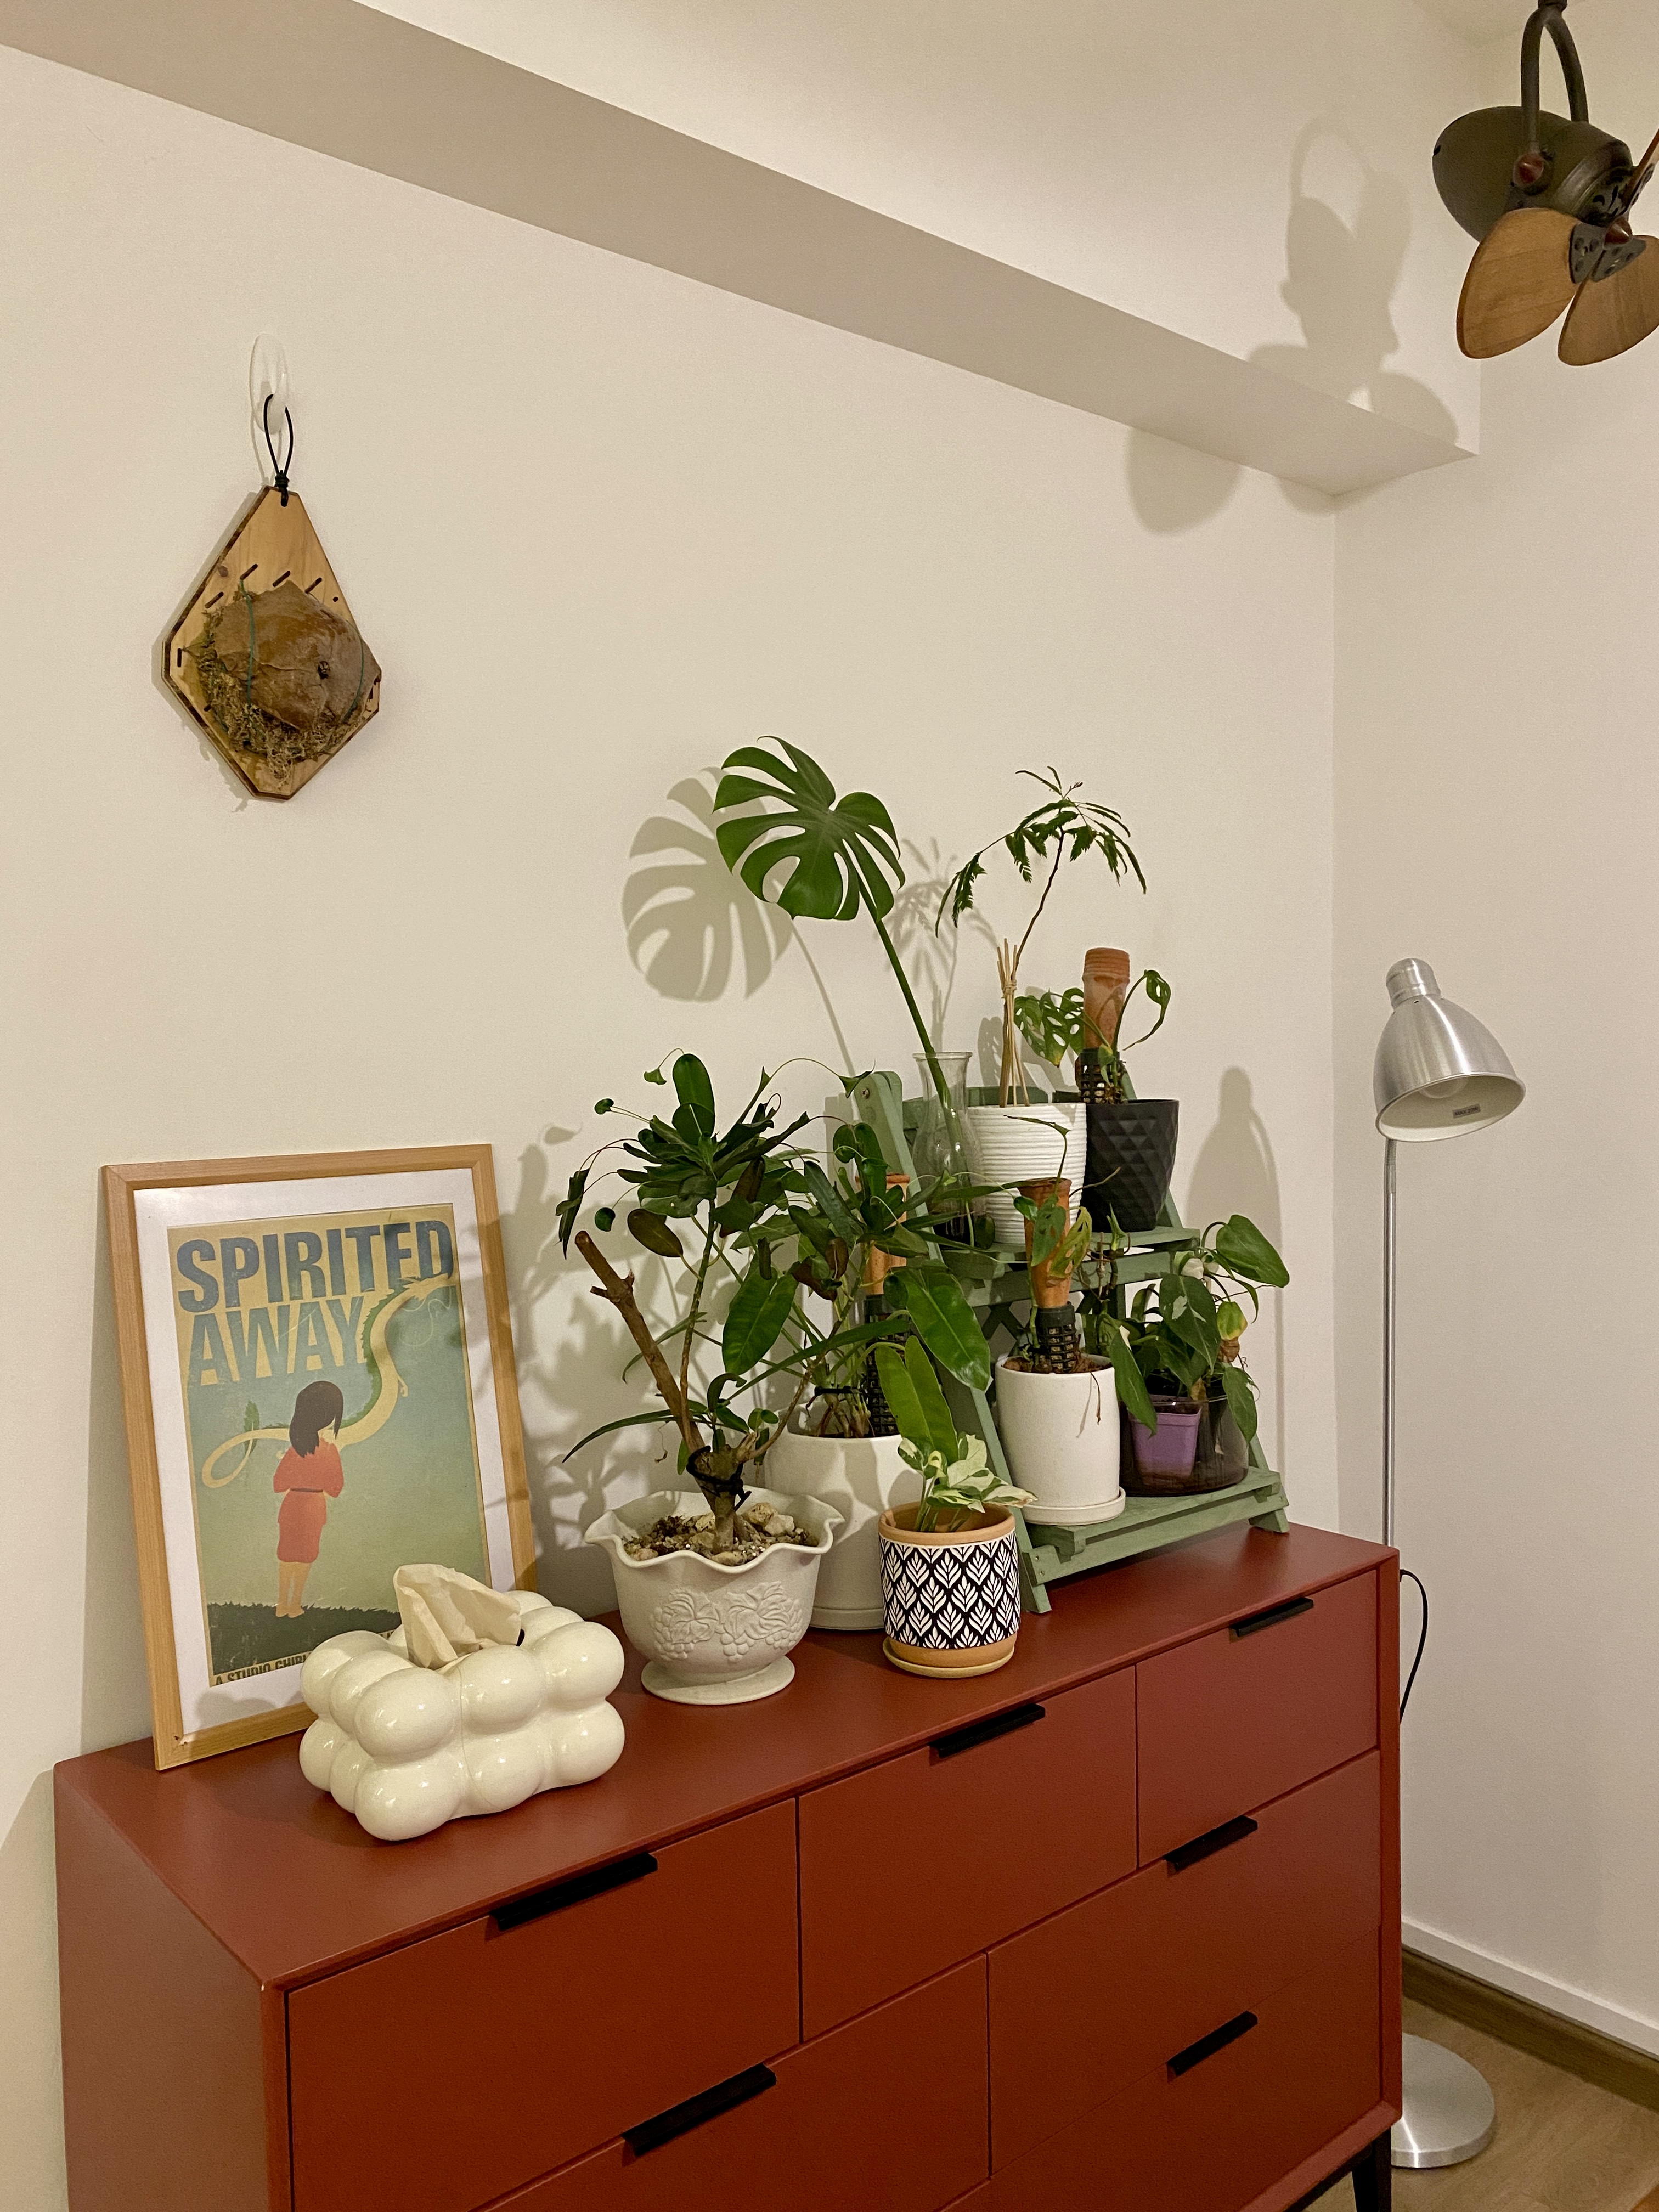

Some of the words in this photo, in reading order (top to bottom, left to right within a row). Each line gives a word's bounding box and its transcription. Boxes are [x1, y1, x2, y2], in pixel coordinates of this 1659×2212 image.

[177, 1220, 454, 1312] SPIRITED
[187, 1296, 366, 1386] AWAY
[216, 1675, 223, 1685] A
[227, 1663, 270, 1681] STUDIO
